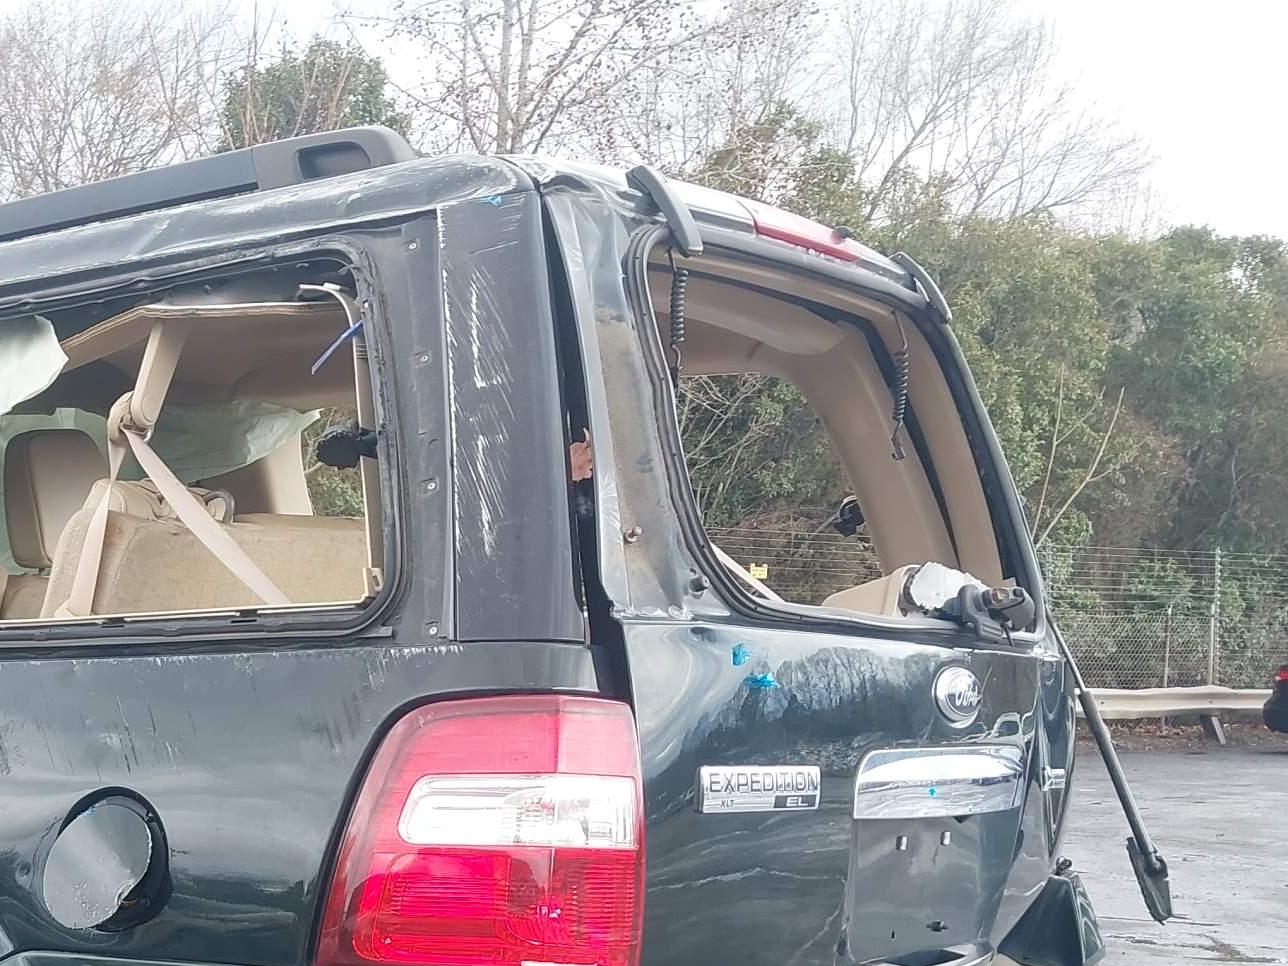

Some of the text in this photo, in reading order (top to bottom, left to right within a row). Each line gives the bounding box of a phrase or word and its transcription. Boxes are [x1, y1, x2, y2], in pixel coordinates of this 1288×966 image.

[709, 772, 818, 793] EXPEDITION
[720, 799, 735, 809] XLT
[786, 796, 809, 807] EL
